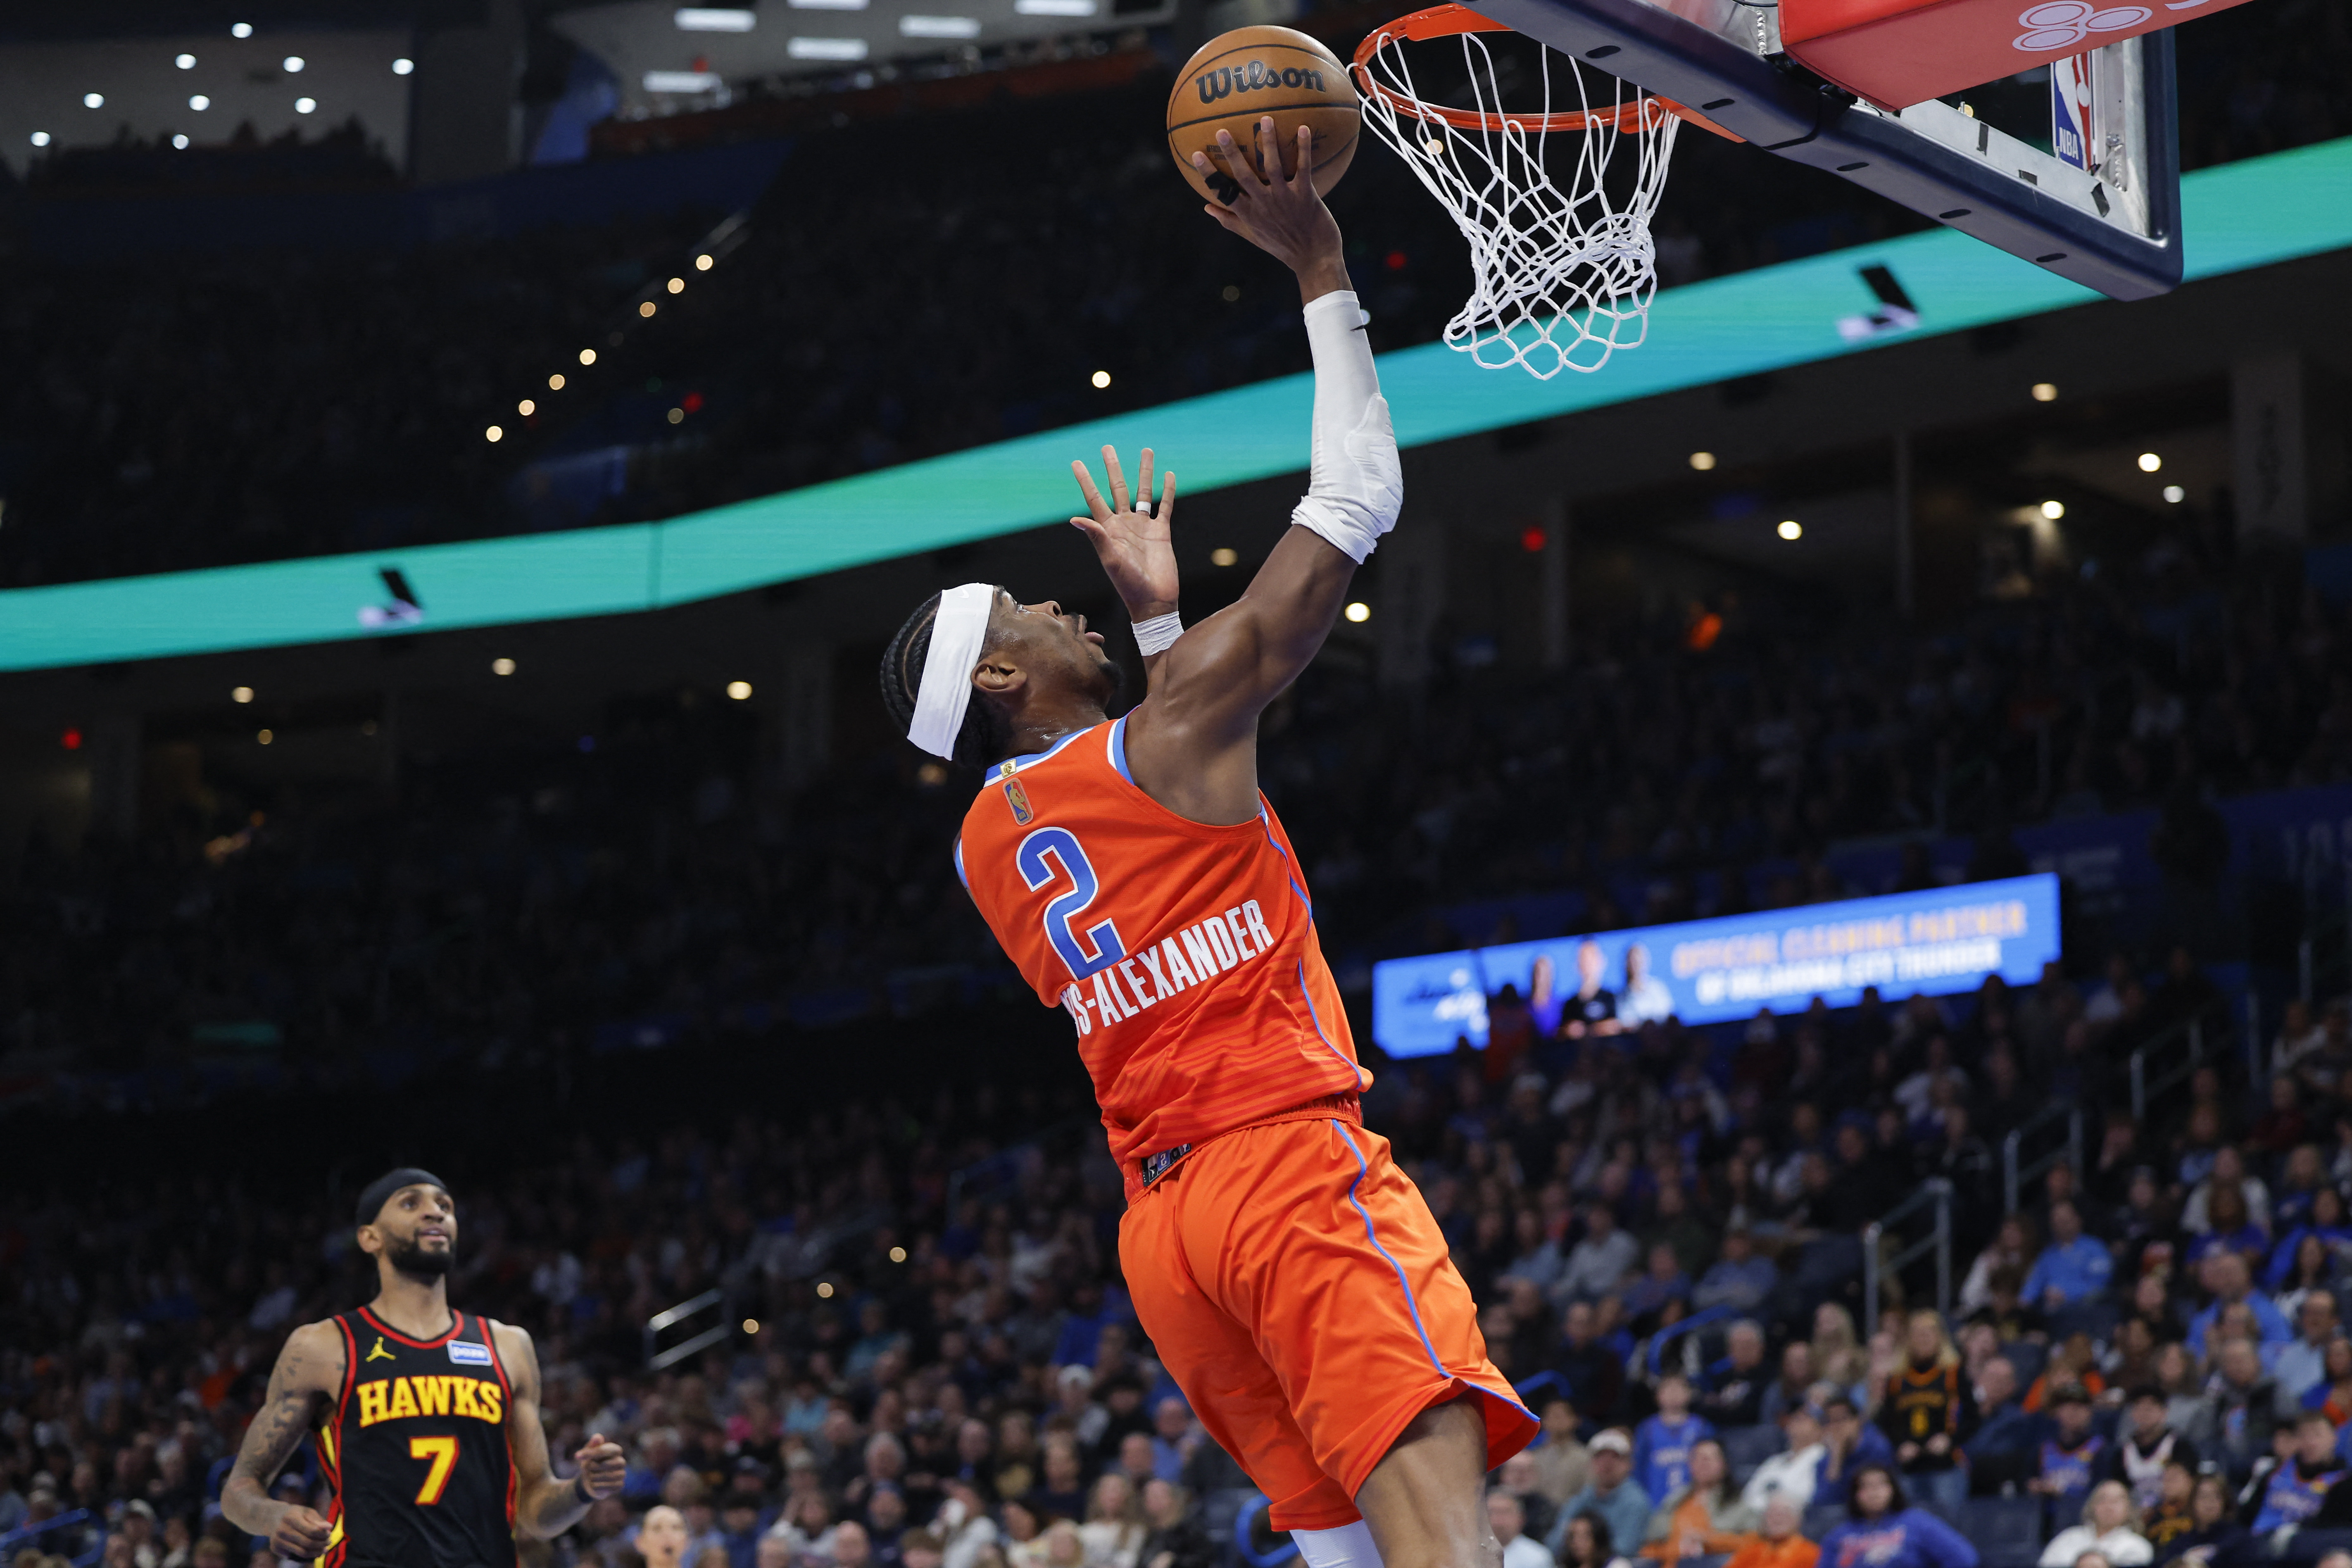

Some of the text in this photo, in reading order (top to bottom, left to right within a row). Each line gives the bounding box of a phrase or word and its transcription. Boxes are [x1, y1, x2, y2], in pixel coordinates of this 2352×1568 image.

[1196, 59, 1325, 104] Wilson
[2059, 127, 2079, 160] NBA
[1015, 826, 1127, 981] 2
[356, 1375, 502, 1428] HAWKS
[409, 1435, 459, 1505] 7
